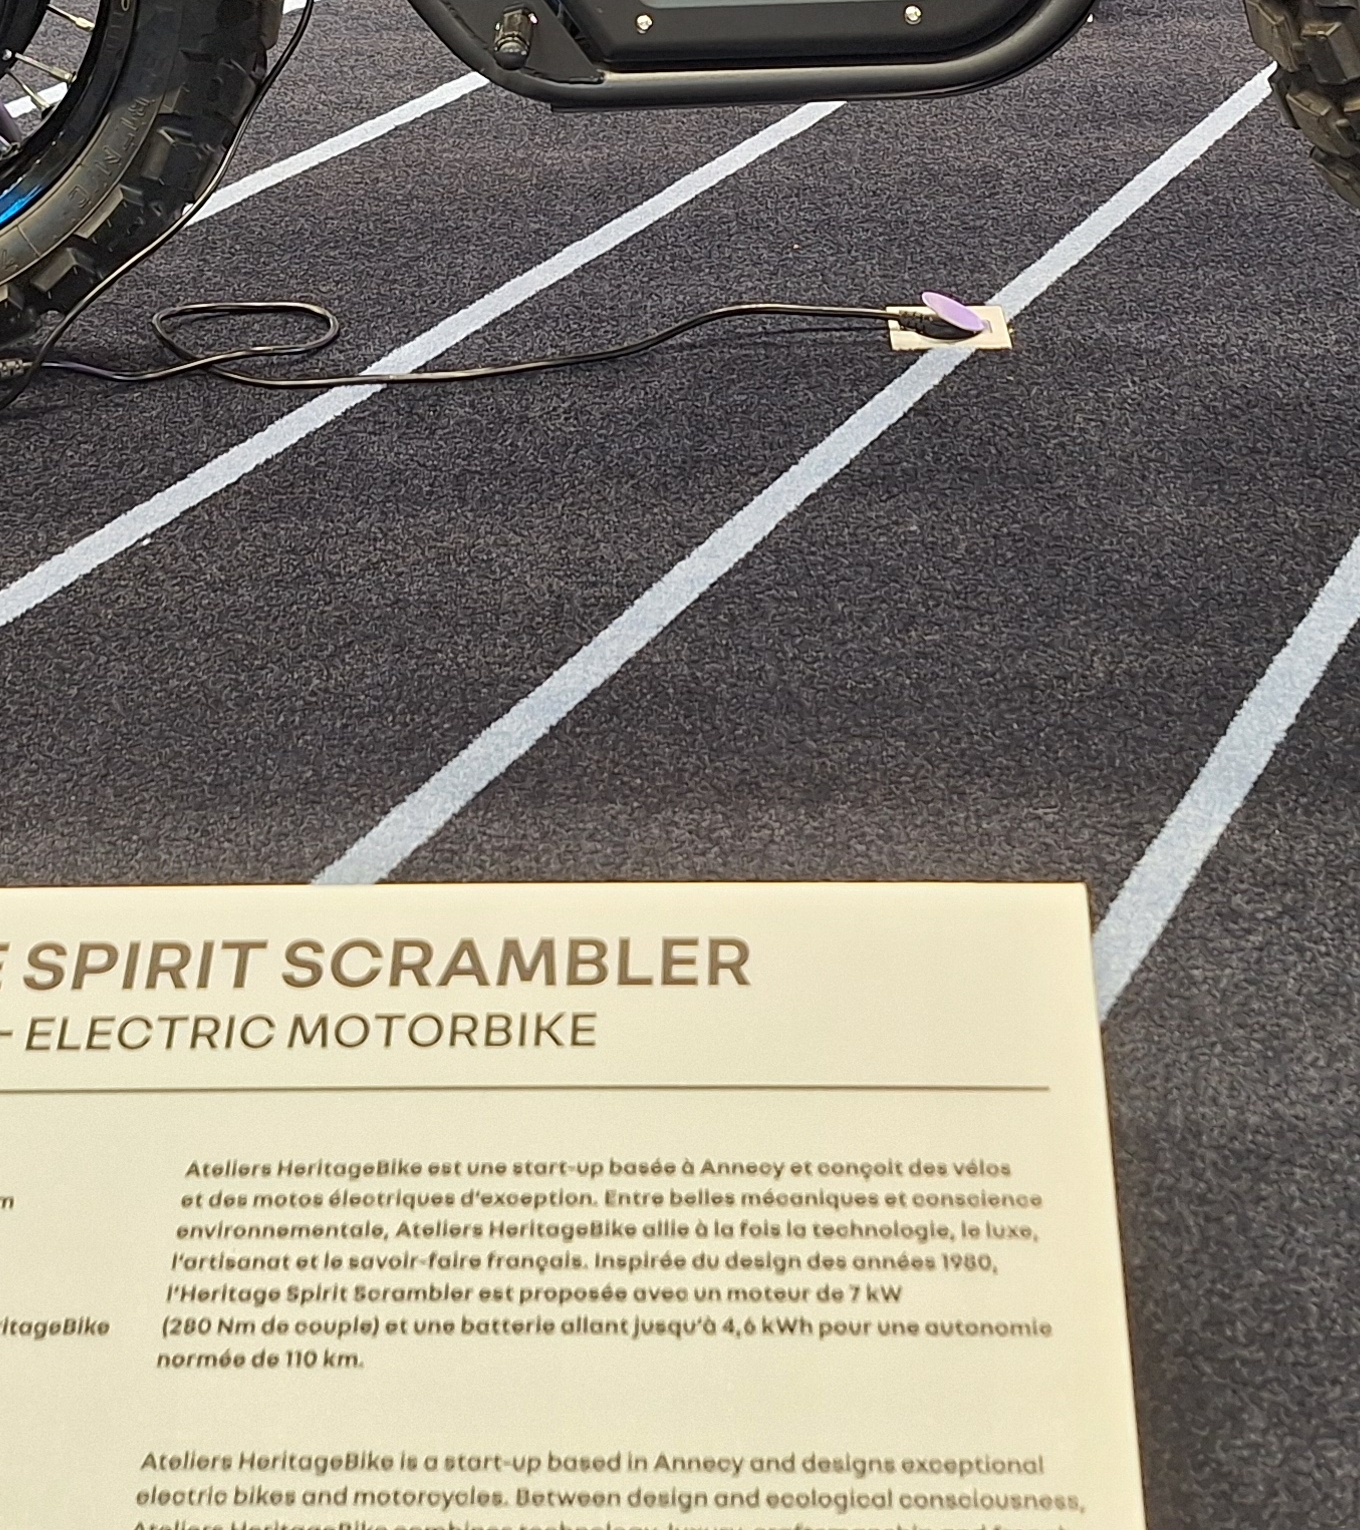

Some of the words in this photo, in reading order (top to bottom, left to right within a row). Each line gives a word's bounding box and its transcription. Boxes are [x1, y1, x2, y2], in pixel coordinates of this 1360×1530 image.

[22, 939, 269, 992] SPIRIT
[281, 937, 751, 989] SCRAMBLER
[24, 1013, 276, 1052] ELECTRIC
[286, 1011, 598, 1050] MOTORBIKE
[184, 1158, 272, 1180] Ateliers
[276, 1157, 423, 1183] HeritageBike
[427, 1160, 463, 1178] est
[466, 1161, 508, 1178] une
[511, 1159, 605, 1181] start-up
[608, 1156, 677, 1178] basée
[680, 1157, 696, 1178] à
[699, 1158, 786, 1182] Annecy
[789, 1160, 814, 1178] et
[816, 1157, 904, 1183] conçoit
[907, 1157, 950, 1178] des
[952, 1158, 1012, 1179] vélos
[180, 1192, 205, 1210] et
[208, 1189, 248, 1210] des
[252, 1191, 324, 1210] motos
[328, 1188, 456, 1213] électriques
[604, 1188, 665, 1208] Entre
[669, 1187, 736, 1208] belles
[740, 1187, 880, 1213] mécaniques
[883, 1190, 908, 1209] et
[911, 1188, 1043, 1210] conscience
[175, 1219, 389, 1243] environnementale,
[394, 1218, 484, 1240] Ateliers
[488, 1218, 638, 1244] HeritageBike
[641, 1218, 690, 1240] allie
[694, 1218, 709, 1240] à
[713, 1218, 735, 1240] la
[739, 1218, 783, 1240] fois
[786, 1218, 807, 1240] la
[811, 1219, 956, 1245] technologie,
[960, 1220, 981, 1241] le
[985, 1219, 1039, 1244] luxe,
[295, 1253, 320, 1272] et
[323, 1250, 344, 1272] le
[347, 1250, 482, 1272] savoir-faire
[486, 1249, 589, 1276] français.
[594, 1250, 687, 1276] Inspirée
[691, 1251, 720, 1272] du
[724, 1250, 802, 1276] design
[806, 1250, 848, 1272] des
[851, 1250, 938, 1273] années
[940, 1252, 999, 1276] 1980,
[285, 1282, 349, 1308] Spirit
[352, 1281, 474, 1304] Scrambler
[478, 1284, 515, 1304] est
[518, 1282, 628, 1308] proposée
[632, 1286, 689, 1304] avec
[693, 1286, 723, 1304] un
[725, 1285, 811, 1304] moteur
[815, 1282, 845, 1304] de
[848, 1283, 861, 1304] 7
[865, 1282, 904, 1304] kW
[161, 1315, 213, 1340] (280
[216, 1316, 257, 1337] Nm
[260, 1314, 290, 1337] de
[294, 1314, 380, 1341] couple)
[384, 1317, 409, 1337] et
[412, 1318, 456, 1337] une
[460, 1314, 556, 1337] batterie
[559, 1314, 630, 1337] allant
[721, 1316, 757, 1340] 4,6
[761, 1314, 814, 1337] kWh
[818, 1320, 873, 1342] pour
[876, 1320, 921, 1338] une
[924, 1317, 1053, 1339] autonomie
[156, 1347, 247, 1370] normée
[250, 1347, 281, 1370] de
[285, 1348, 319, 1370] 110
[322, 1347, 365, 1369] km.
[139, 1449, 233, 1473] Ateliers
[237, 1449, 395, 1477] HeritageBike
[399, 1449, 418, 1473] is
[422, 1455, 439, 1473] a
[443, 1453, 542, 1477] start-up
[546, 1449, 622, 1474] based
[627, 1450, 648, 1473] in
[653, 1451, 746, 1479] Annecy
[749, 1451, 797, 1475] and
[800, 1451, 897, 1480] designs
[900, 1453, 1045, 1479] exceptional
[135, 1484, 228, 1507] electric
[233, 1484, 296, 1507] bikes
[301, 1485, 349, 1507] and
[352, 1484, 509, 1512] motorcycles.
[515, 1486, 622, 1508] Between
[626, 1485, 708, 1515] design
[713, 1486, 761, 1509] and
[765, 1486, 894, 1515] ecological
[898, 1487, 1086, 1515] consciousness,
